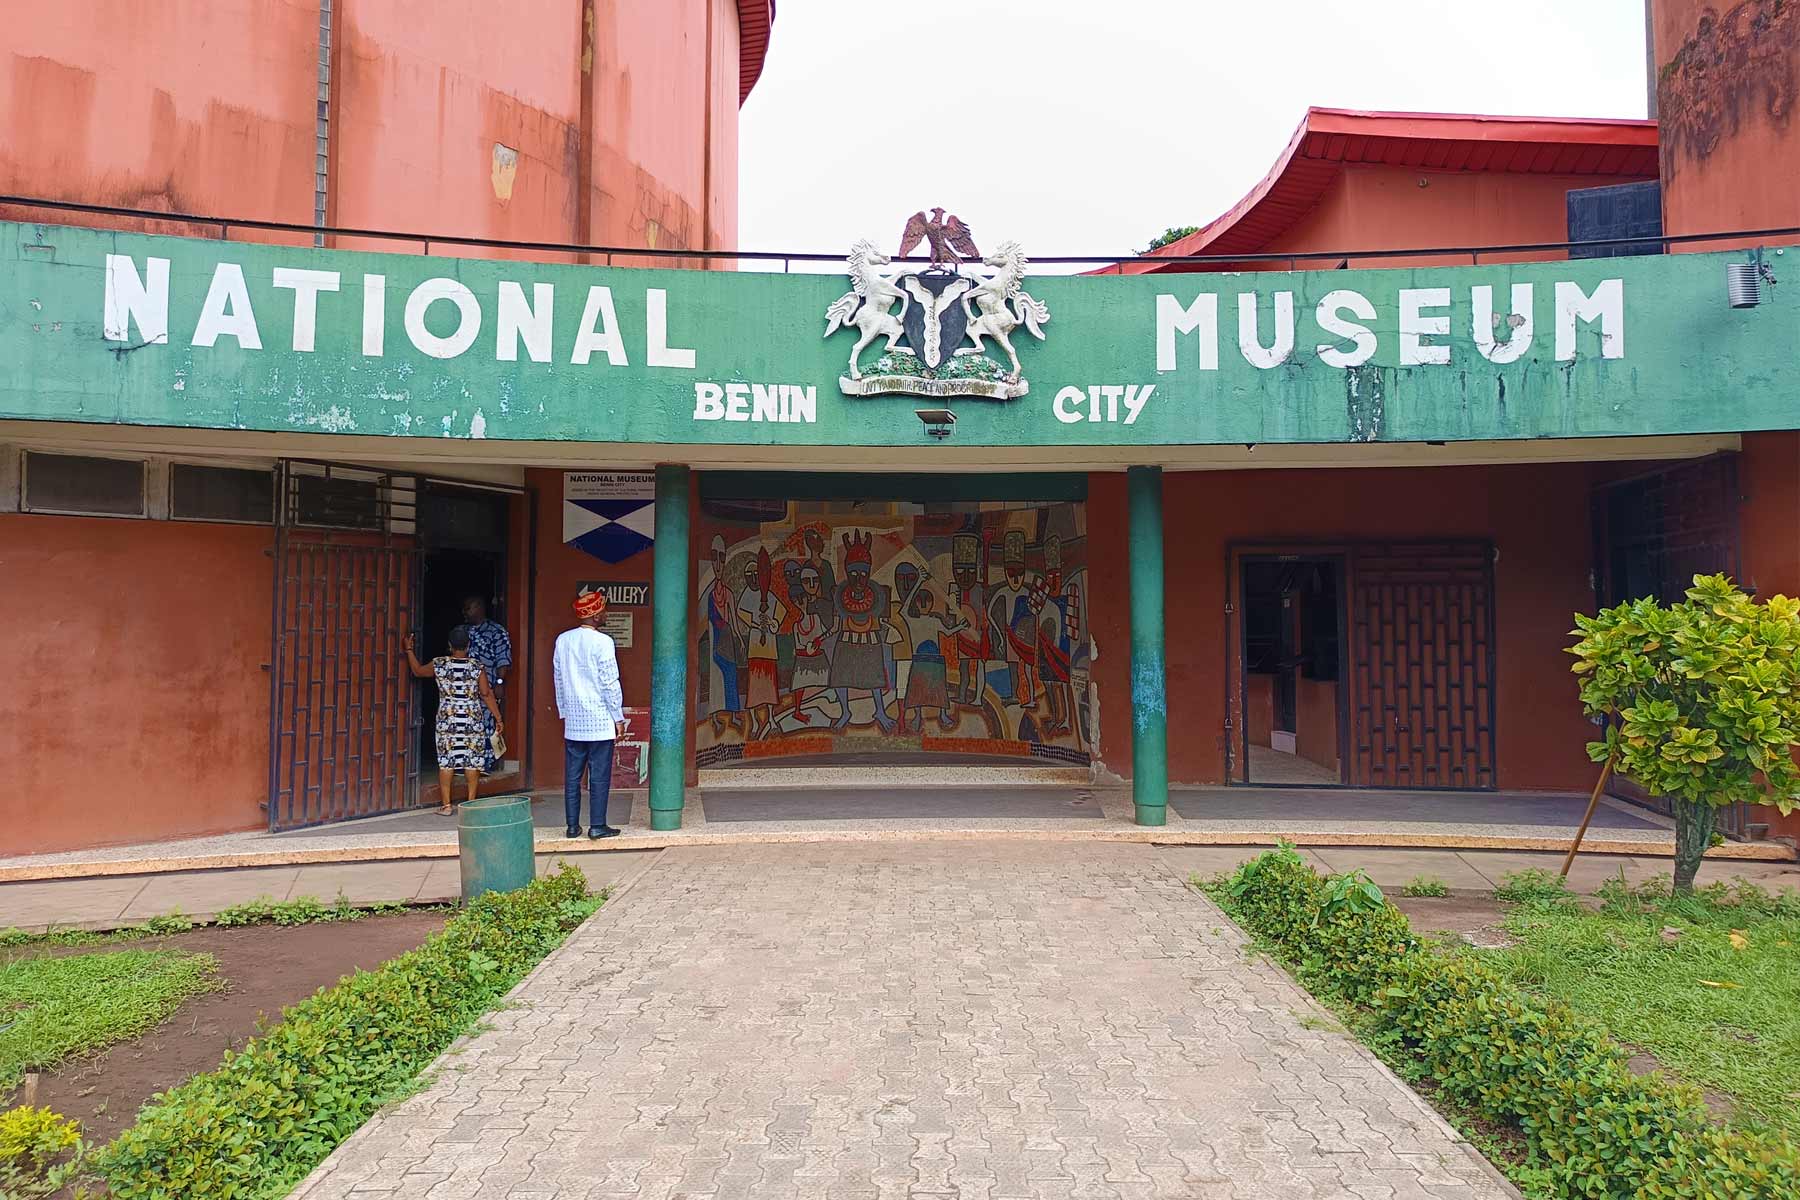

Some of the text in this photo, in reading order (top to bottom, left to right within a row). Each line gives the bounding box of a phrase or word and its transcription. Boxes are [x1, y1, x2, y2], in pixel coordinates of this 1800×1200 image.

[104, 254, 1625, 371] NATIONAL MUSEUM
[693, 383, 1156, 426] BENIN CITY
[570, 475, 655, 483] NATIONAL MUSEUM
